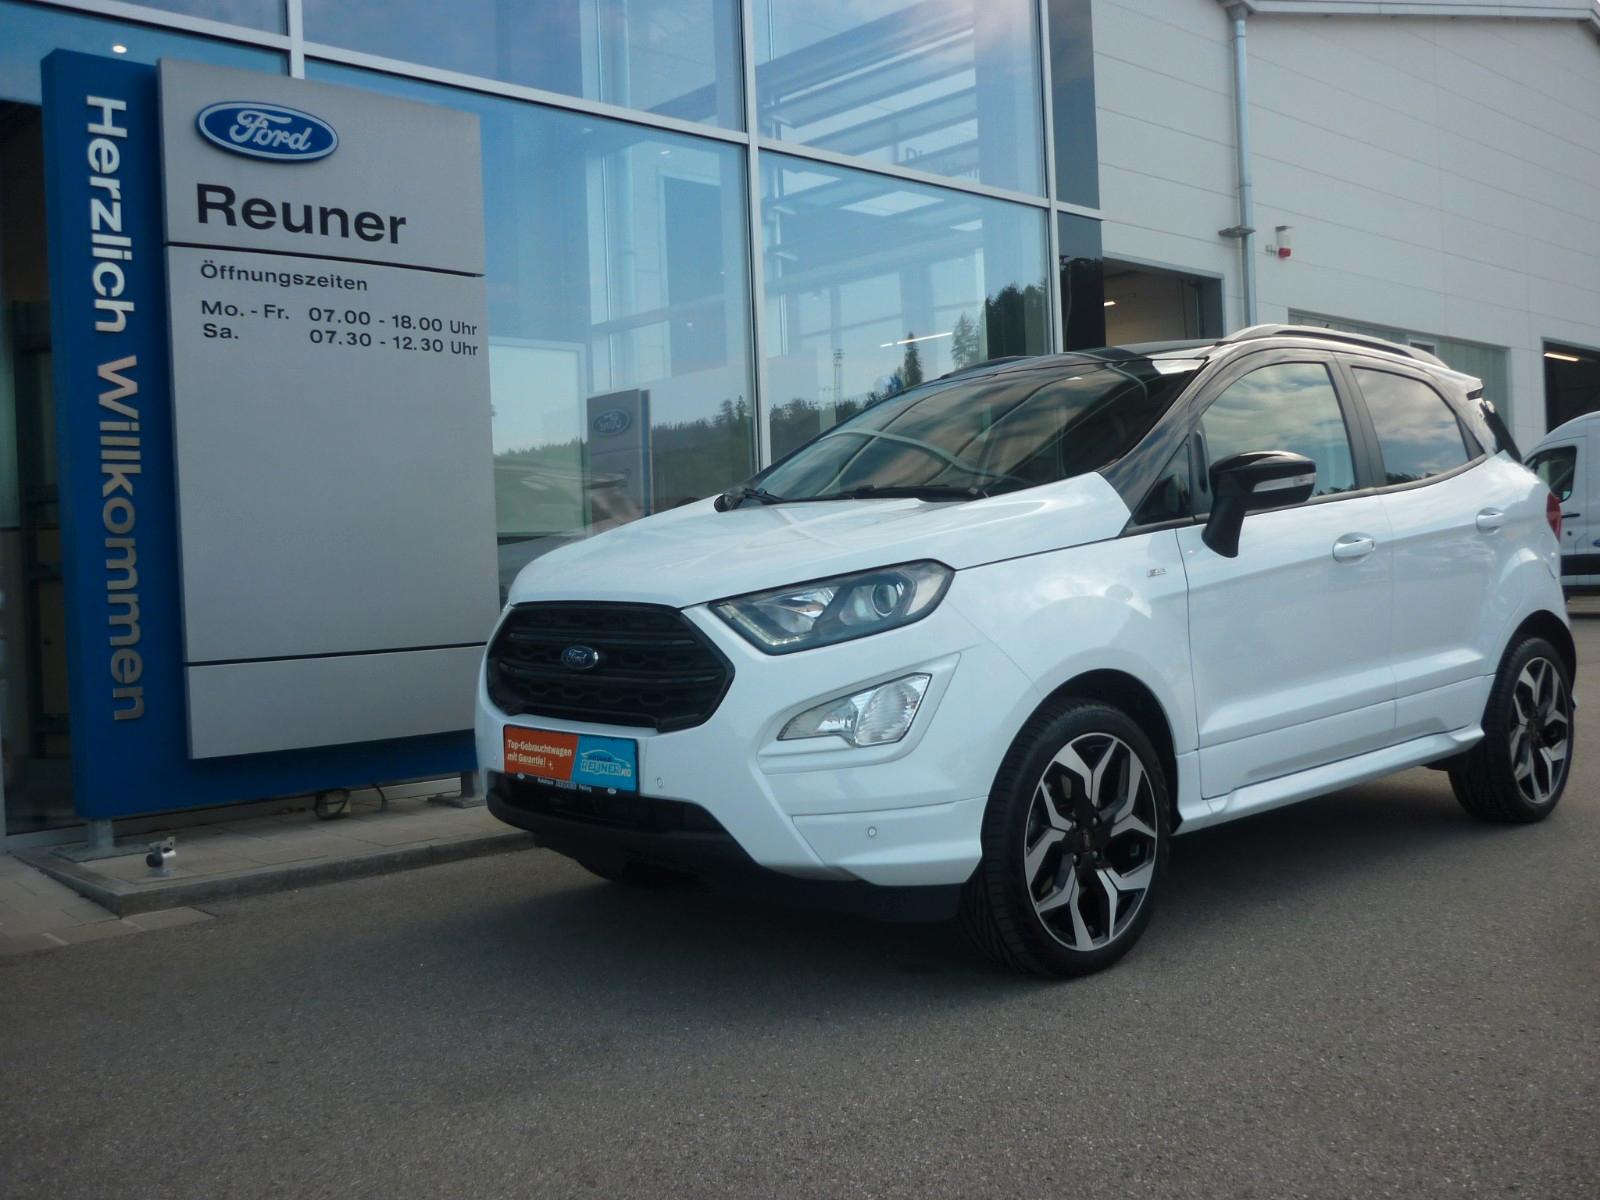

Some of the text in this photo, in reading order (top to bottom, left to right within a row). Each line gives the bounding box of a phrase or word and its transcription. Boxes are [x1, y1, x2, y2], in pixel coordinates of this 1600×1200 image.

[229, 110, 313, 151] Ford
[196, 182, 407, 245] Reuner
[200, 259, 368, 291] Öffnungszeiten
[201, 299, 245, 317] Mo.
[263, 303, 290, 320] Fr.
[308, 306, 371, 326] 07.00
[391, 315, 443, 332] 18.00
[450, 319, 478, 336] Uhr
[202, 322, 239, 340] Sa.
[309, 329, 372, 347] 07.30
[392, 335, 444, 353] 12.30
[451, 340, 478, 356] Uhr
[86, 95, 146, 721] Herzlich Willkommen
